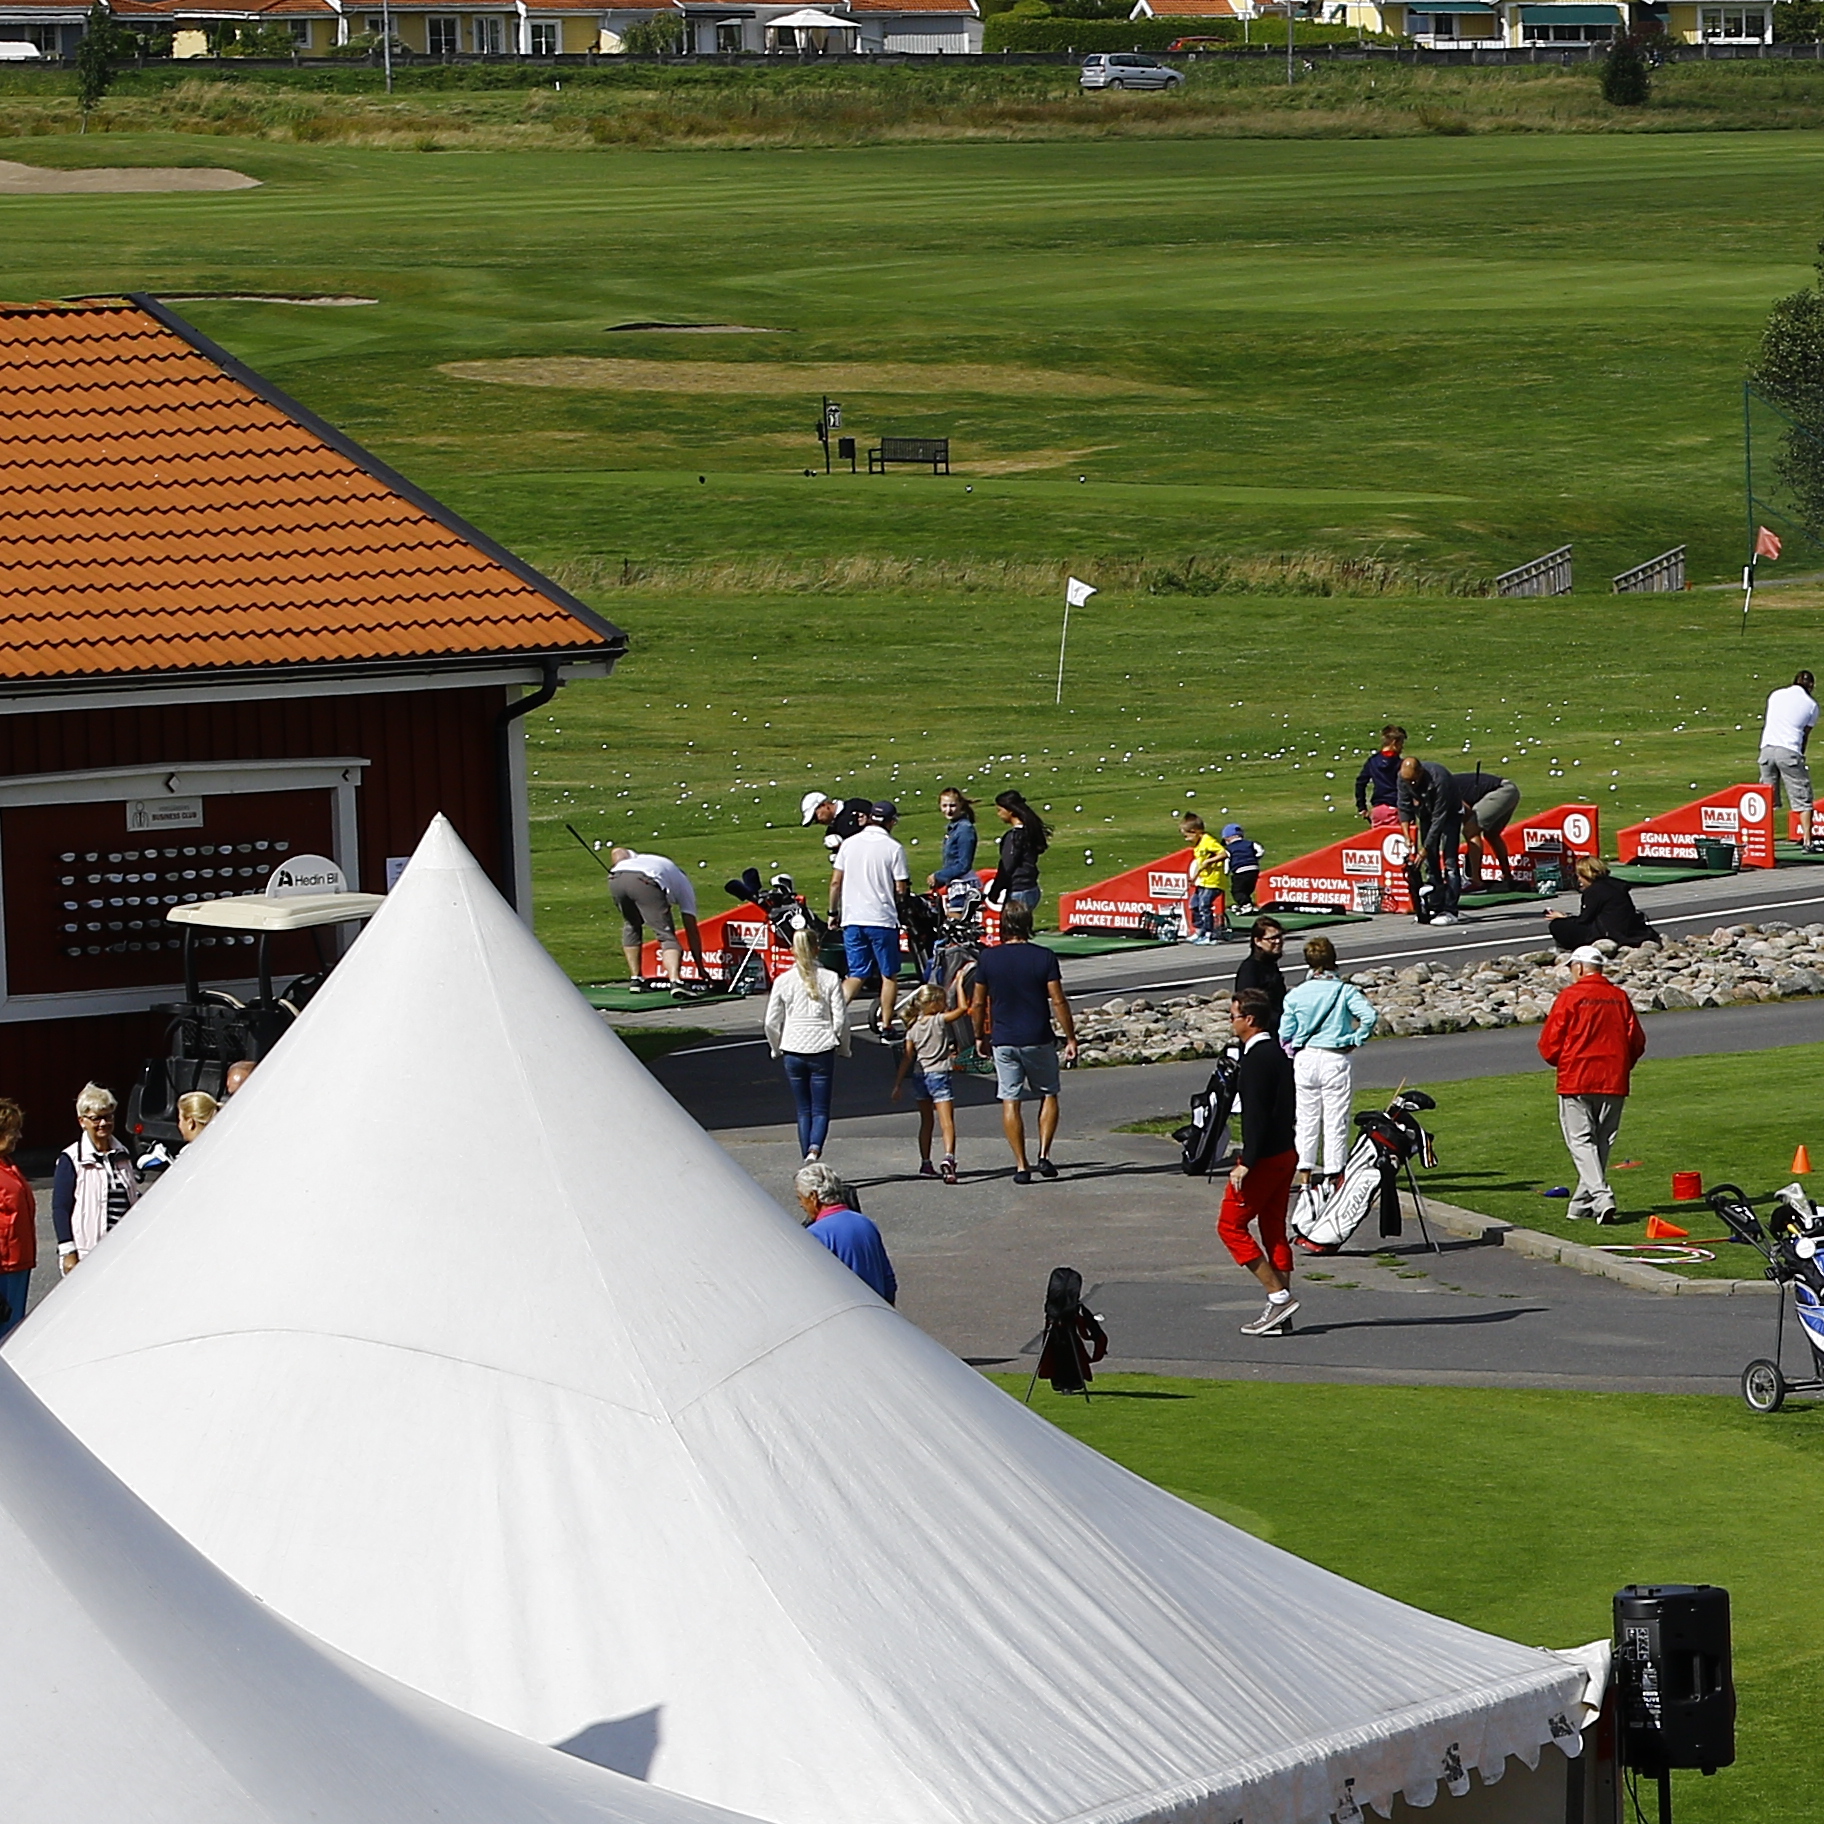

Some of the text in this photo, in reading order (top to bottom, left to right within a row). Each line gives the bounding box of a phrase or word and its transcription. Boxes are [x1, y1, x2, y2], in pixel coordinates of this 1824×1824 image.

[1747, 797, 1757, 817] 6
[1703, 809, 1737, 822] MAXI
[1572, 818, 1582, 839] 5
[1640, 832, 1670, 844] EGNA
[1390, 838, 1401, 860] 4
[1637, 844, 1671, 858] LÄGRE
[1344, 852, 1380, 865] MAXI
[294, 871, 339, 887] Hedin Bil
[1150, 874, 1186, 889] MAXI
[1269, 875, 1351, 891] STÖRRE VOLYM.
[1274, 889, 1351, 904] LÄGRE PRISER!
[1075, 897, 1117, 912] MÅNGA
[1069, 913, 1112, 927] MYCKET
